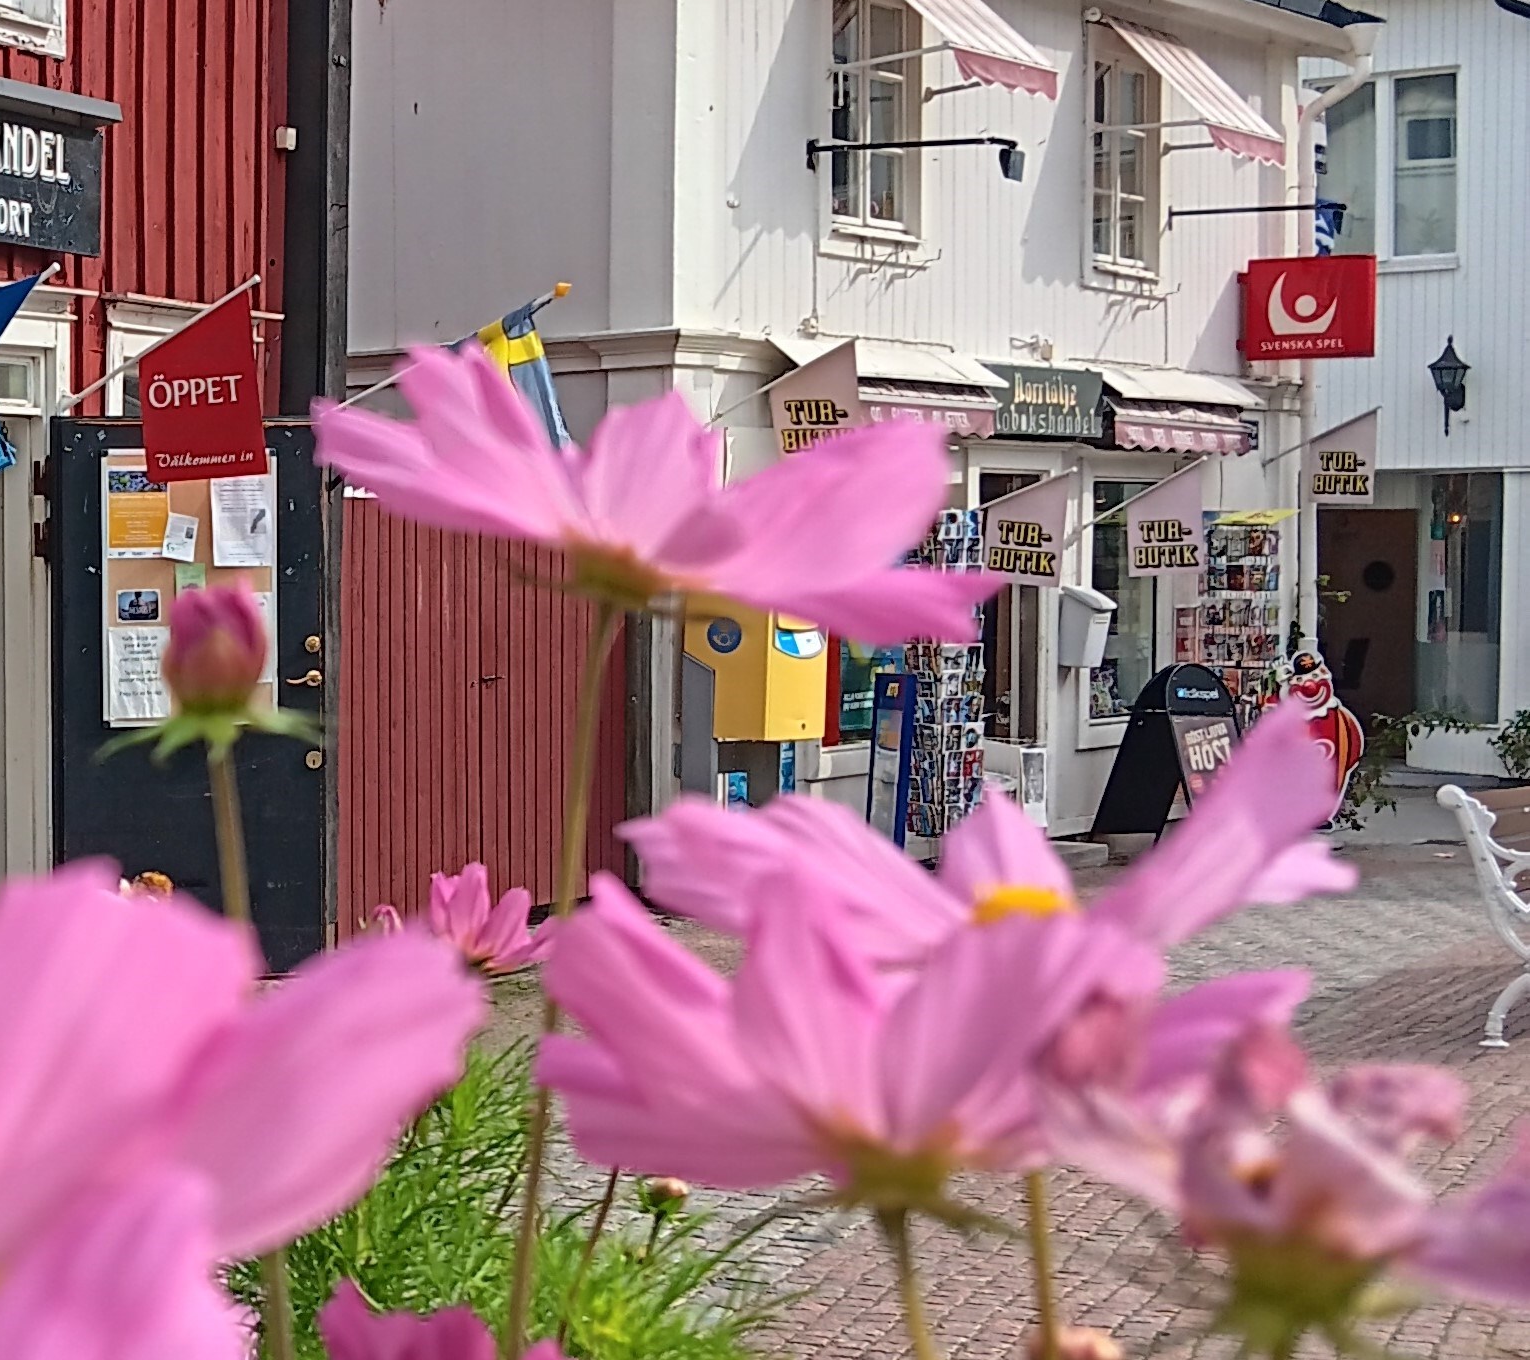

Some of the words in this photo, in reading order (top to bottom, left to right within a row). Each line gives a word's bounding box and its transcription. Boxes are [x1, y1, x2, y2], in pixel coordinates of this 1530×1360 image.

[1260, 339, 1313, 352] SVENSKA
[1316, 338, 1344, 349] SPEL
[148, 374, 243, 408] ÖPPET
[784, 400, 849, 425] TUR-
[154, 451, 236, 468] Välkommen
[239, 449, 254, 462] in
[1319, 452, 1366, 472] TUR-
[1313, 474, 1369, 495] BUTIK
[998, 520, 1052, 547] TUR-
[1138, 520, 1193, 543] TUR-
[988, 546, 1056, 577] BUTIK
[1134, 545, 1199, 569] BUTIK
